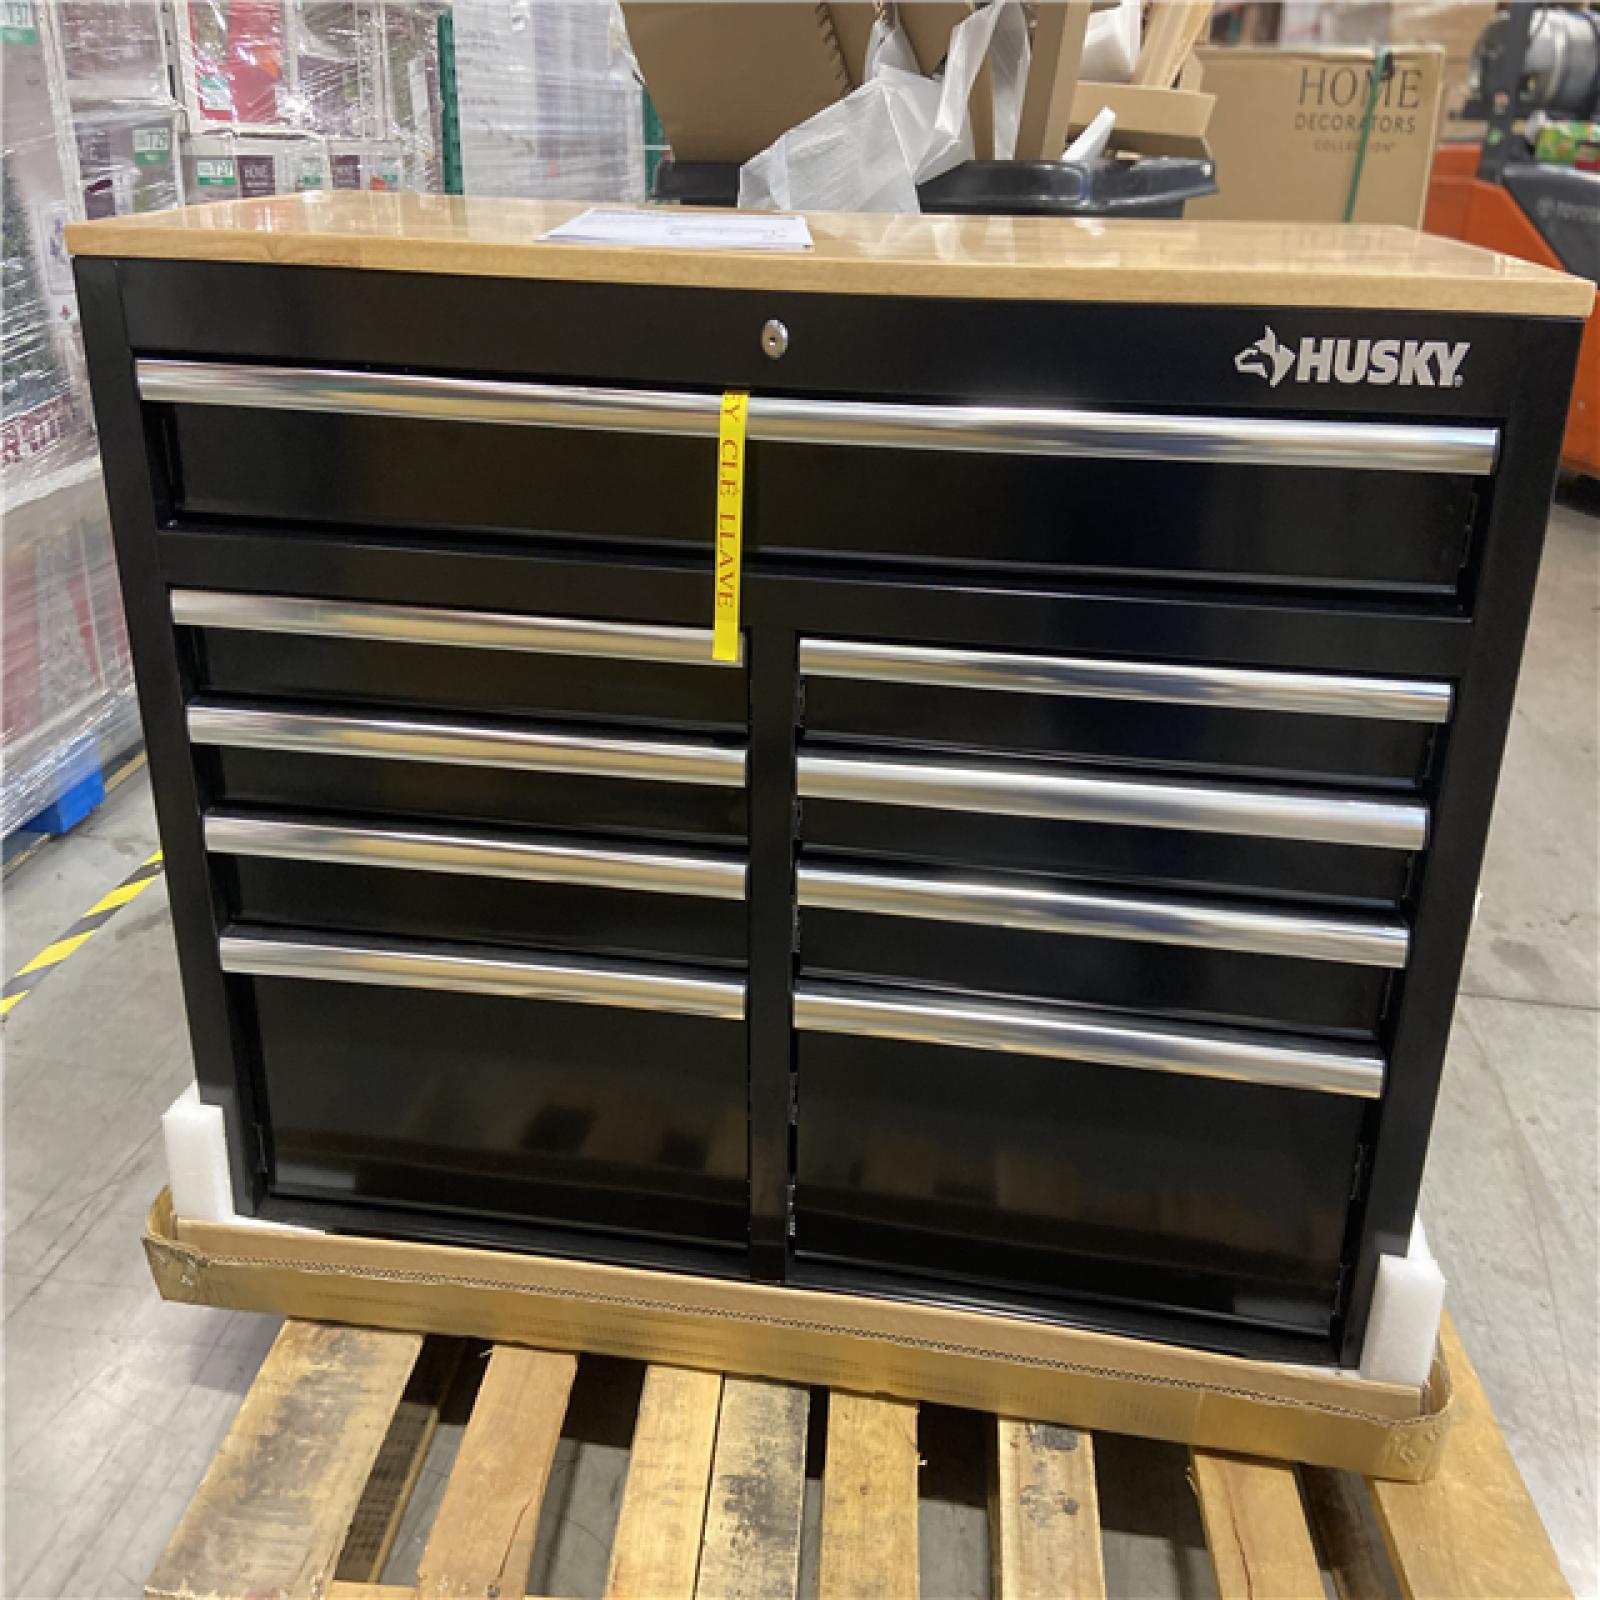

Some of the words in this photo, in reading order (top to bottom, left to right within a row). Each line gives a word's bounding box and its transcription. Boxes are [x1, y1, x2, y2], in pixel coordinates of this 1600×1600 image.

[1298, 66, 1422, 108] HOME
[1296, 336, 1471, 388] HUSKY
[719, 514, 736, 608] LLAVE
